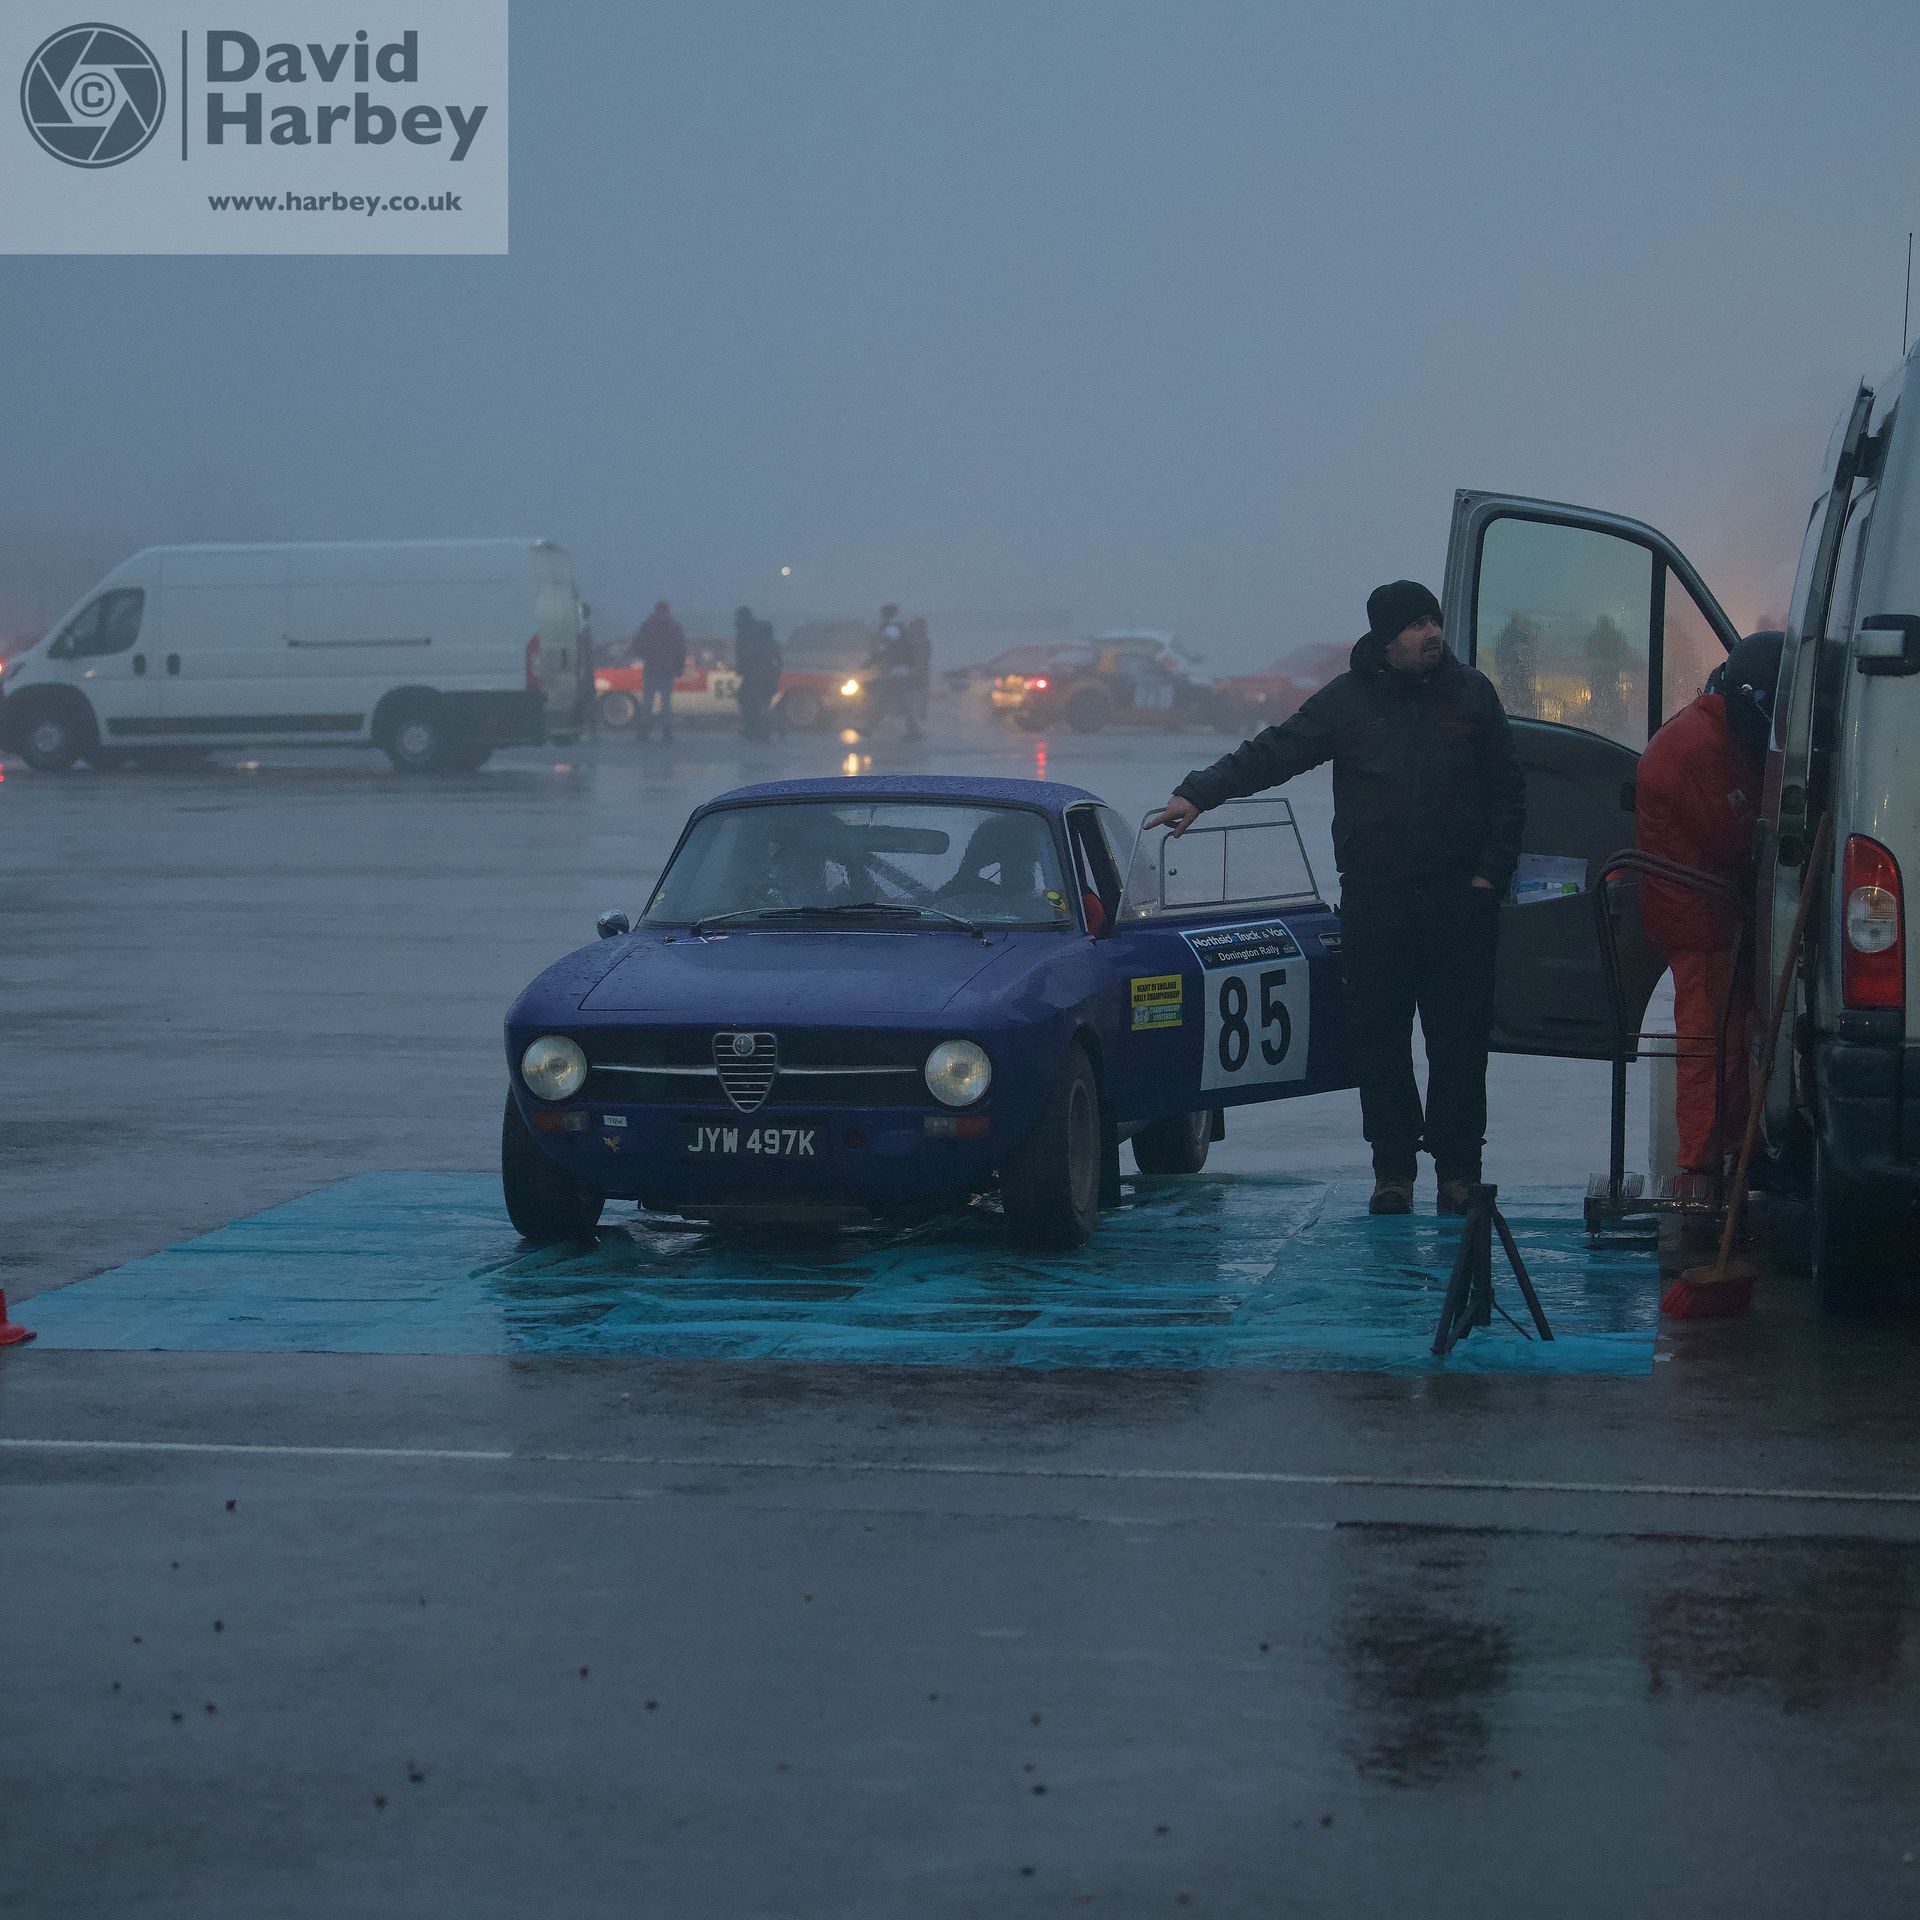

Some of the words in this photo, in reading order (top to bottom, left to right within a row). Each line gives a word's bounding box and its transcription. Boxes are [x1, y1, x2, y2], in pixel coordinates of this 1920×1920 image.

[1192, 934, 1239, 948] Northside
[1234, 931, 1261, 942] Truck
[1266, 928, 1286, 937] Van
[1218, 948, 1259, 961] Donington
[1259, 945, 1280, 955] Rally
[1219, 968, 1291, 1072] 85
[608, 1117, 623, 1125] TOW
[687, 1127, 738, 1153] JYW
[746, 1128, 815, 1156] 497K
